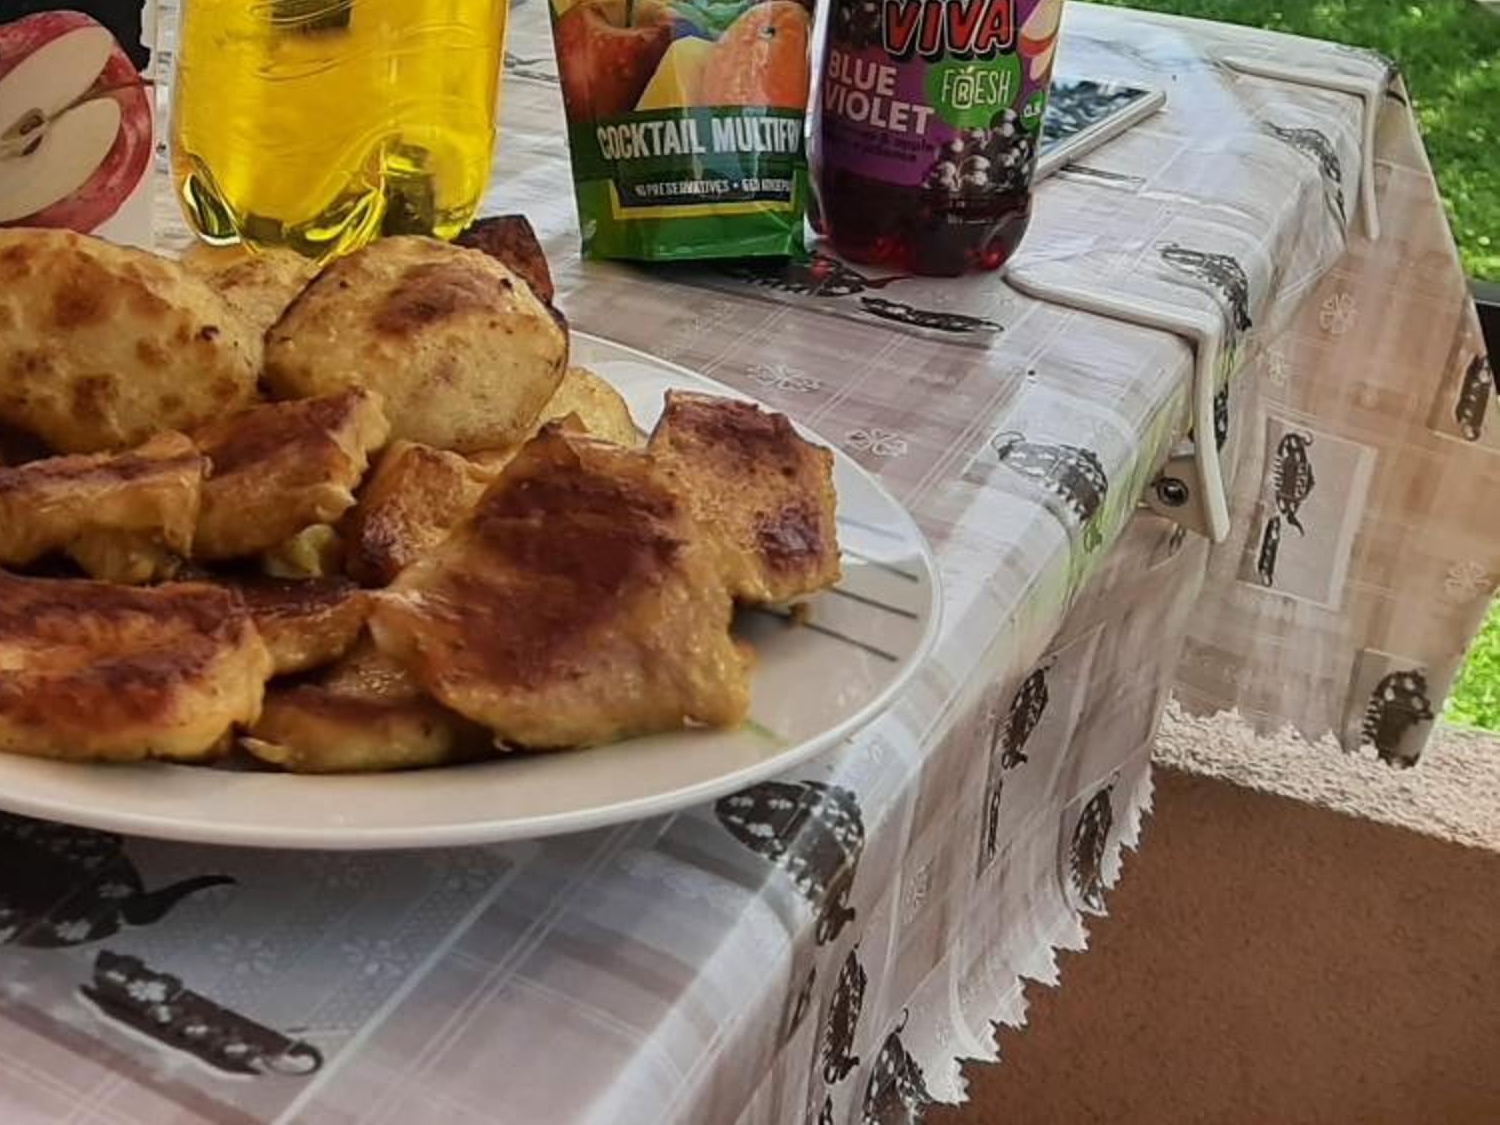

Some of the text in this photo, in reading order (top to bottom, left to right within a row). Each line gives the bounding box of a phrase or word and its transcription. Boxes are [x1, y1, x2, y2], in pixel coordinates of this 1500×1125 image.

[828, 49, 897, 96] BLUE
[825, 78, 935, 135] VIOLET
[596, 118, 706, 160] COCKTAIL
